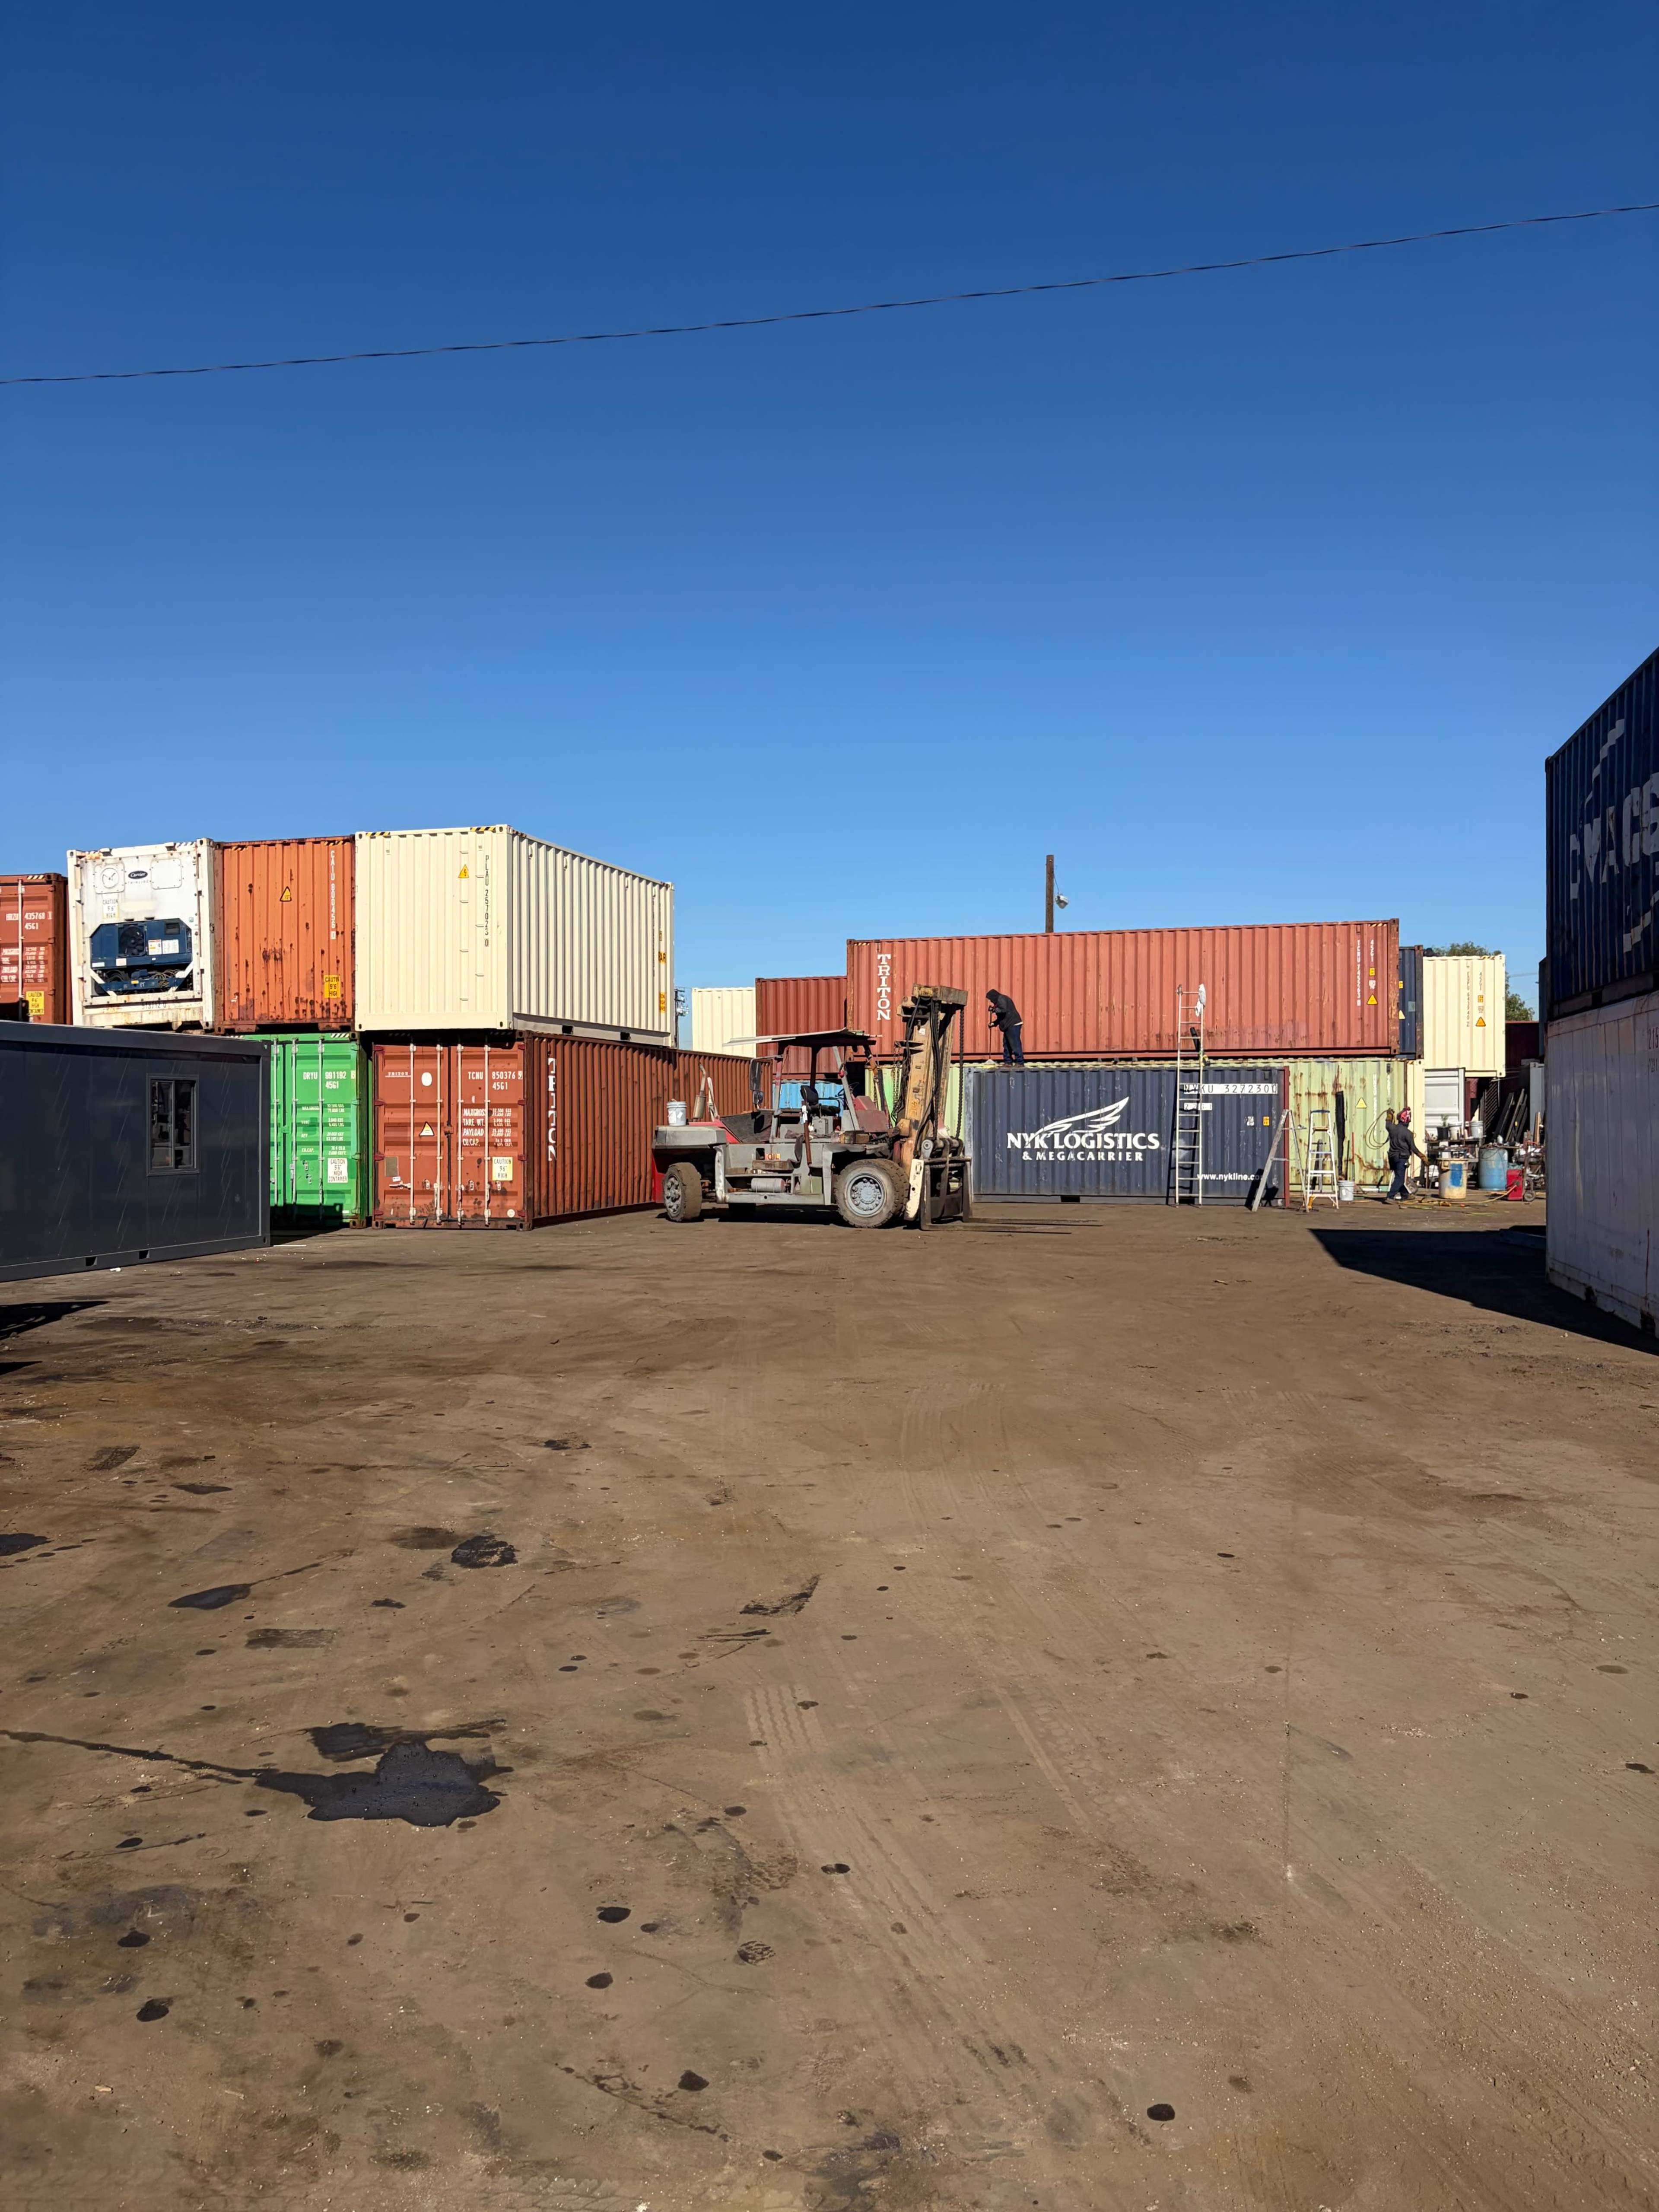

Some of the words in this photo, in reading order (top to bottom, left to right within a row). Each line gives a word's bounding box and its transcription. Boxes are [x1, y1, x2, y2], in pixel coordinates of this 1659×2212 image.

[877, 954, 891, 1020] TRITON
[325, 1071, 346, 1079] 991192
[468, 1071, 483, 1079] TCNU
[492, 1071, 515, 1079] 850376
[518, 1071, 523, 1079] 9
[492, 1082, 508, 1090] 45G1
[1007, 1133, 1049, 1149] NYK
[1054, 1133, 1160, 1149] LOGISTICS
[1022, 1151, 1032, 1161] &
[1036, 1151, 1144, 1161] MEGACARRIER
[1197, 1172, 1262, 1182] www.nykline.co
